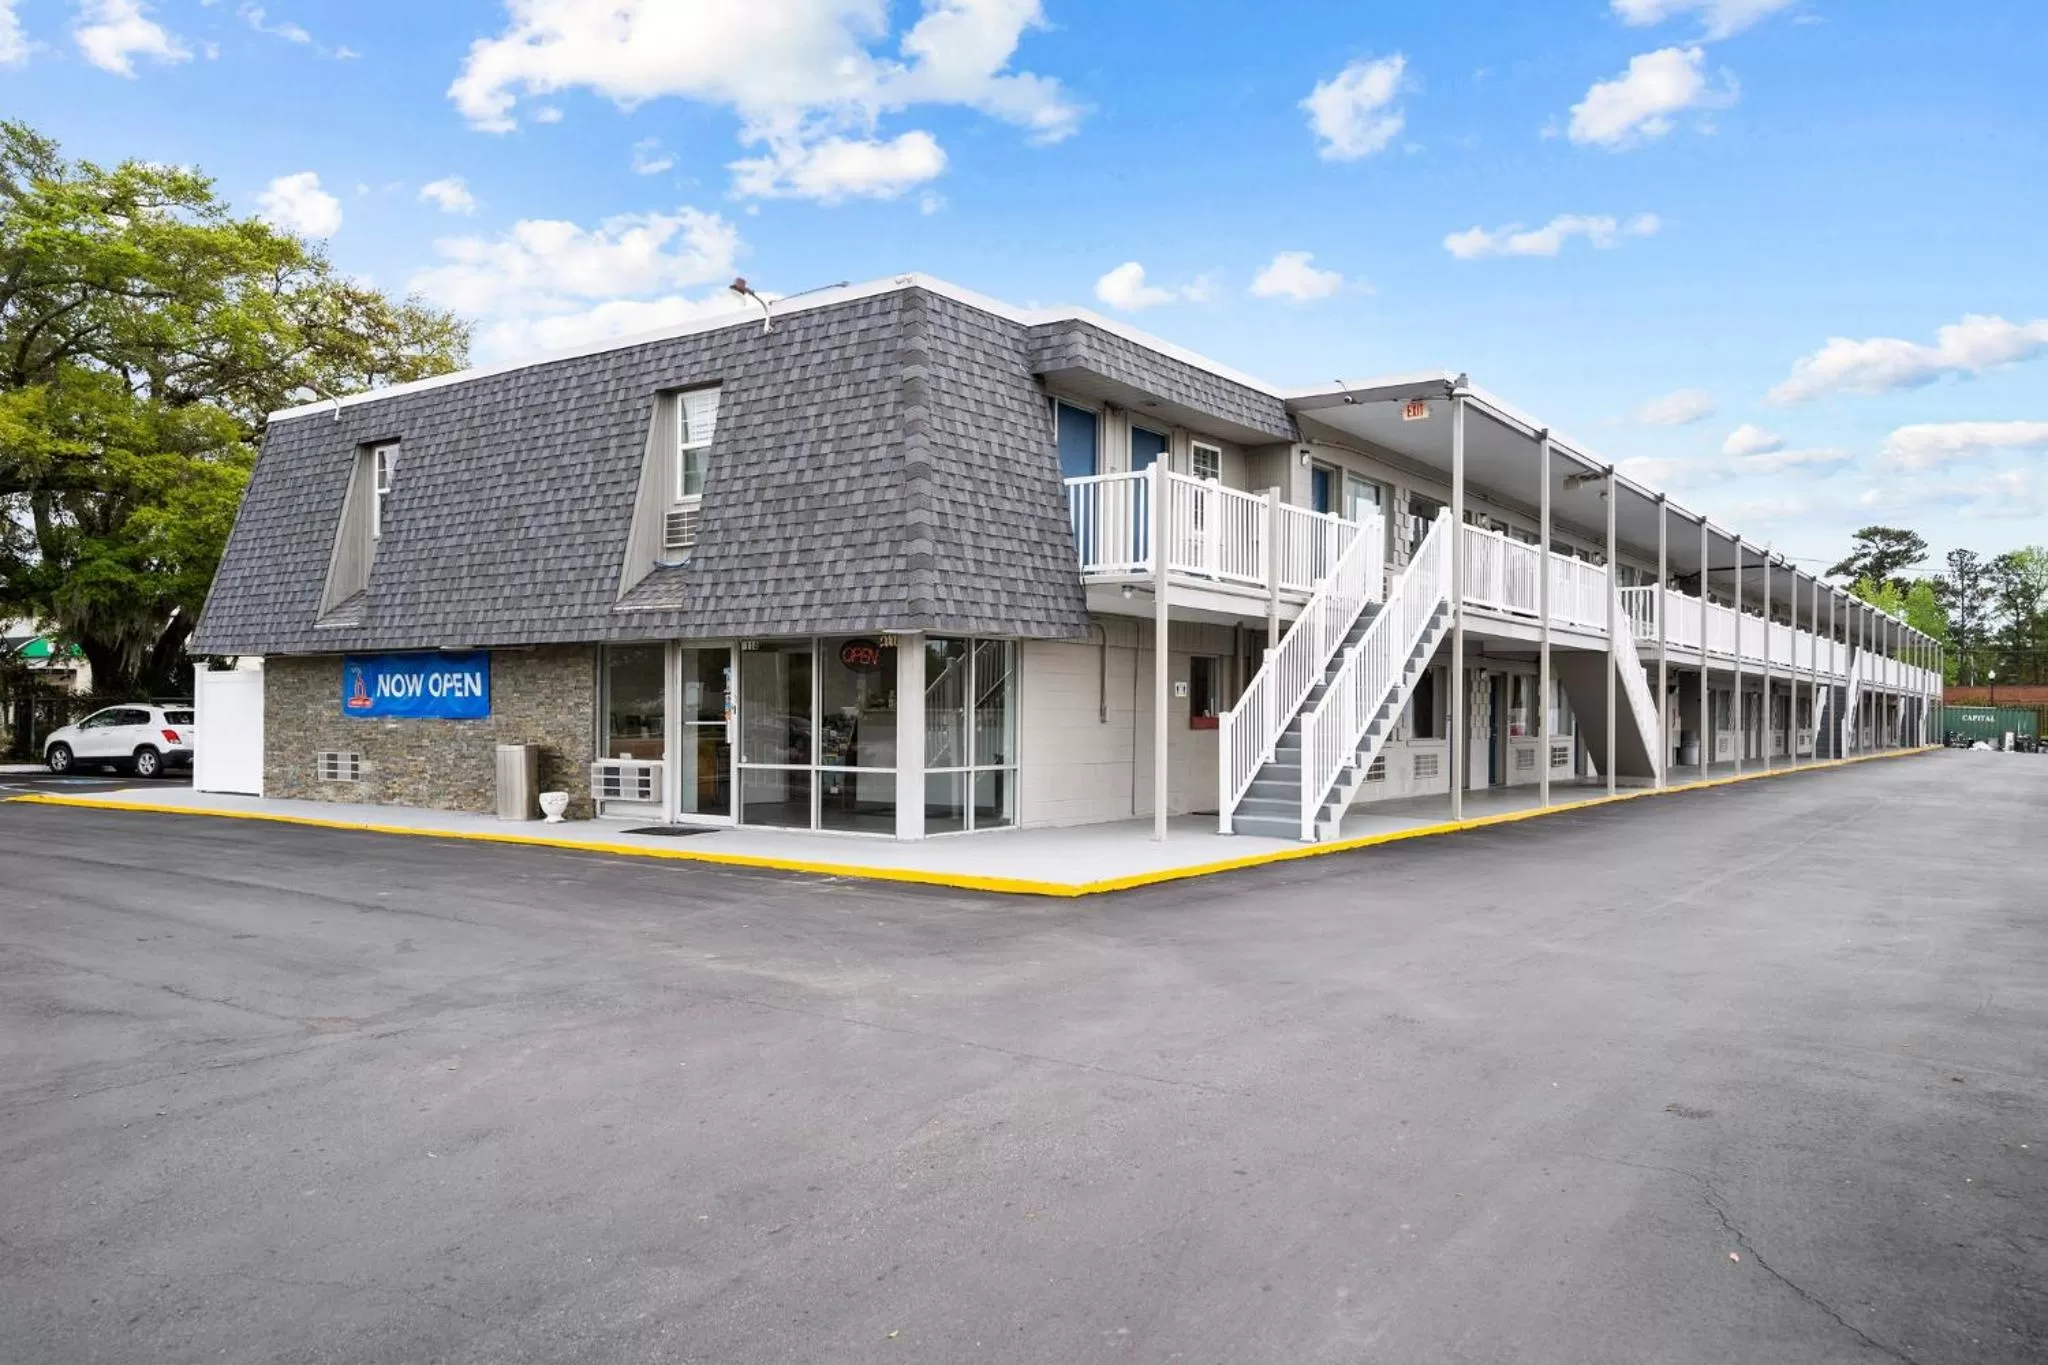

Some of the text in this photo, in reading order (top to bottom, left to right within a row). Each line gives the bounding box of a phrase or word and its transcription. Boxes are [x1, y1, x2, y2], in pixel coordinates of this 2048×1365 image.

[1407, 403, 1424, 418] EXIT
[842, 647, 880, 665] OPEN
[376, 672, 482, 697] NOW OPEN
[1961, 714, 1996, 723] CAPITAL
